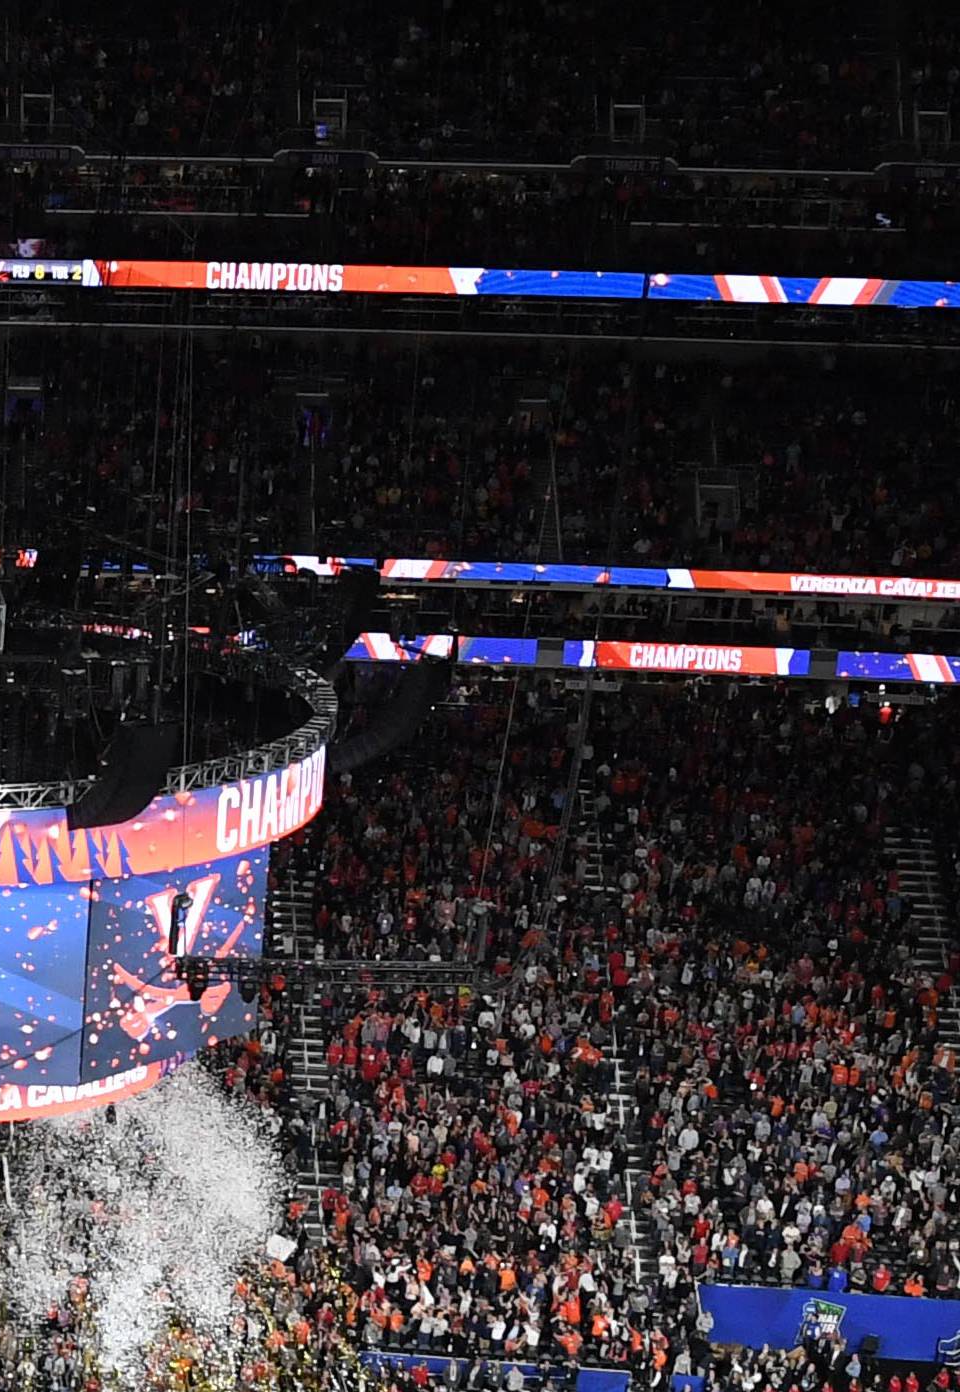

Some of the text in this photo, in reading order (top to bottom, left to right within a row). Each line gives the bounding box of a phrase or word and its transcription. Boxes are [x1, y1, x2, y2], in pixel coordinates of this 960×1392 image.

[72, 264, 82, 280] 2
[206, 261, 344, 293] CHAMPIONS
[790, 575, 877, 595] VIRGINIA
[629, 644, 742, 671] CHAMPIONS
[27, 1065, 148, 1108] CAVALIERS
